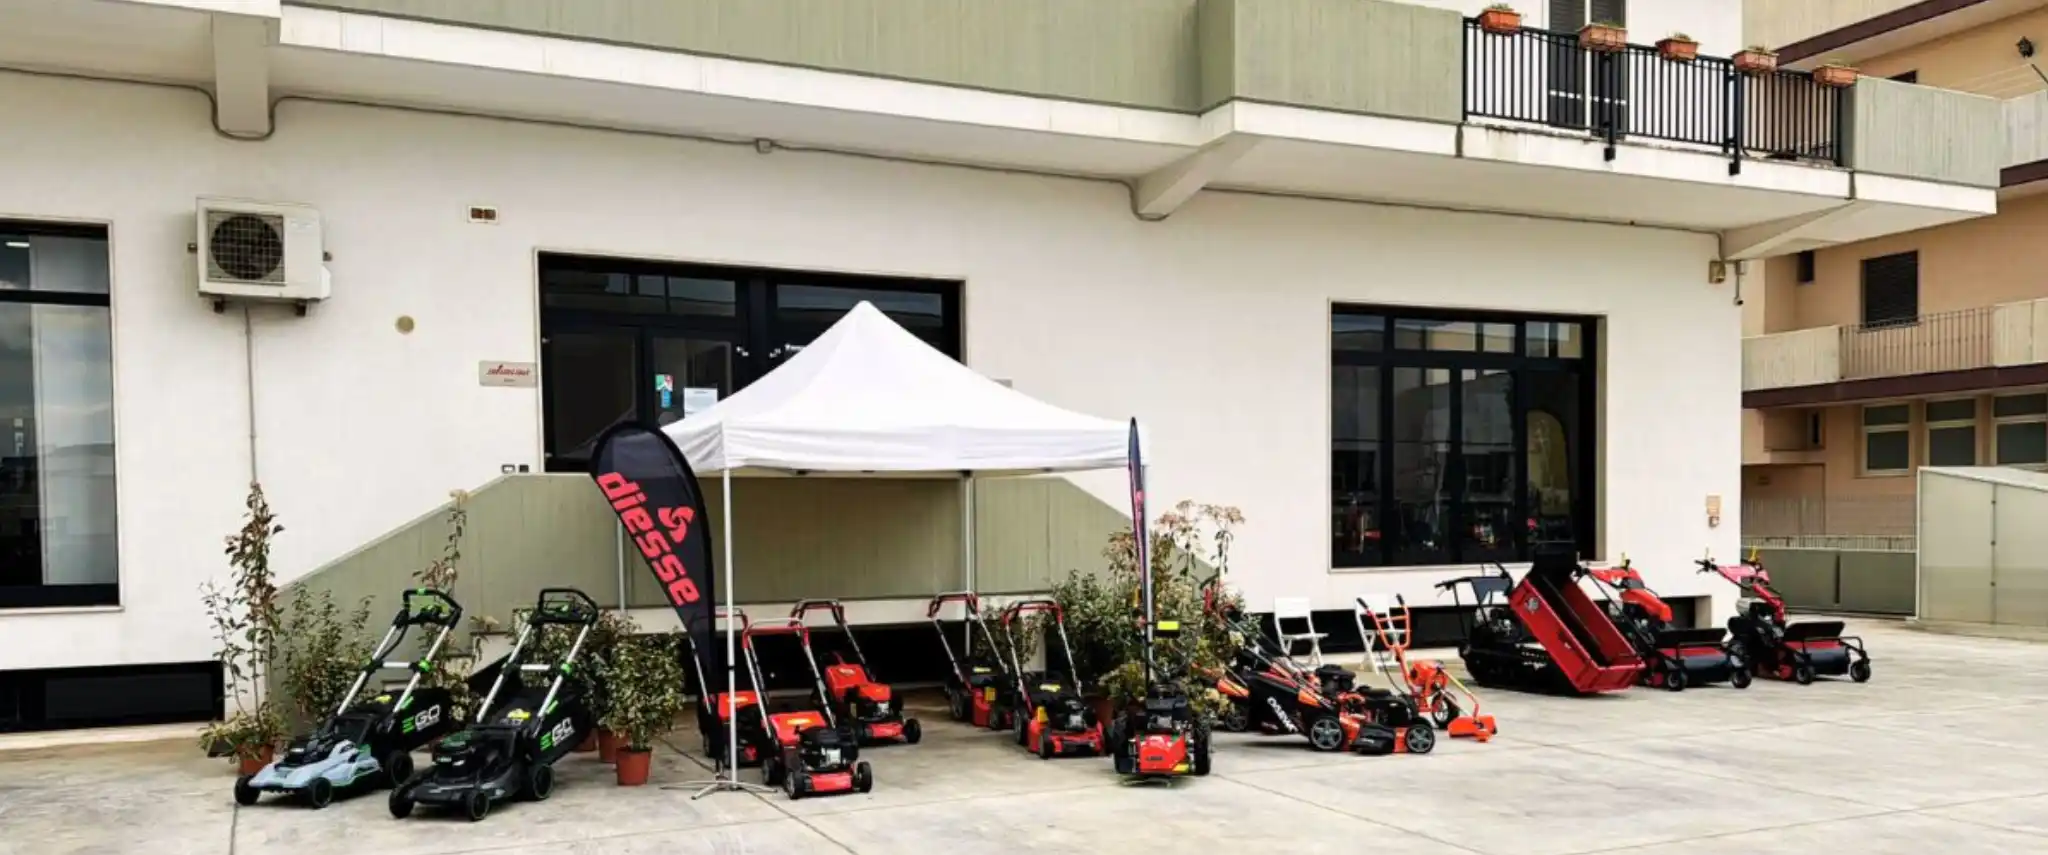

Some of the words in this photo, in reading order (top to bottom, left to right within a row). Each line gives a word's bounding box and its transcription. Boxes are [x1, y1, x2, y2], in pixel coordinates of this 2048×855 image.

[597, 471, 700, 607] diesse
[402, 703, 441, 734] EGO
[540, 717, 573, 752] EGO
